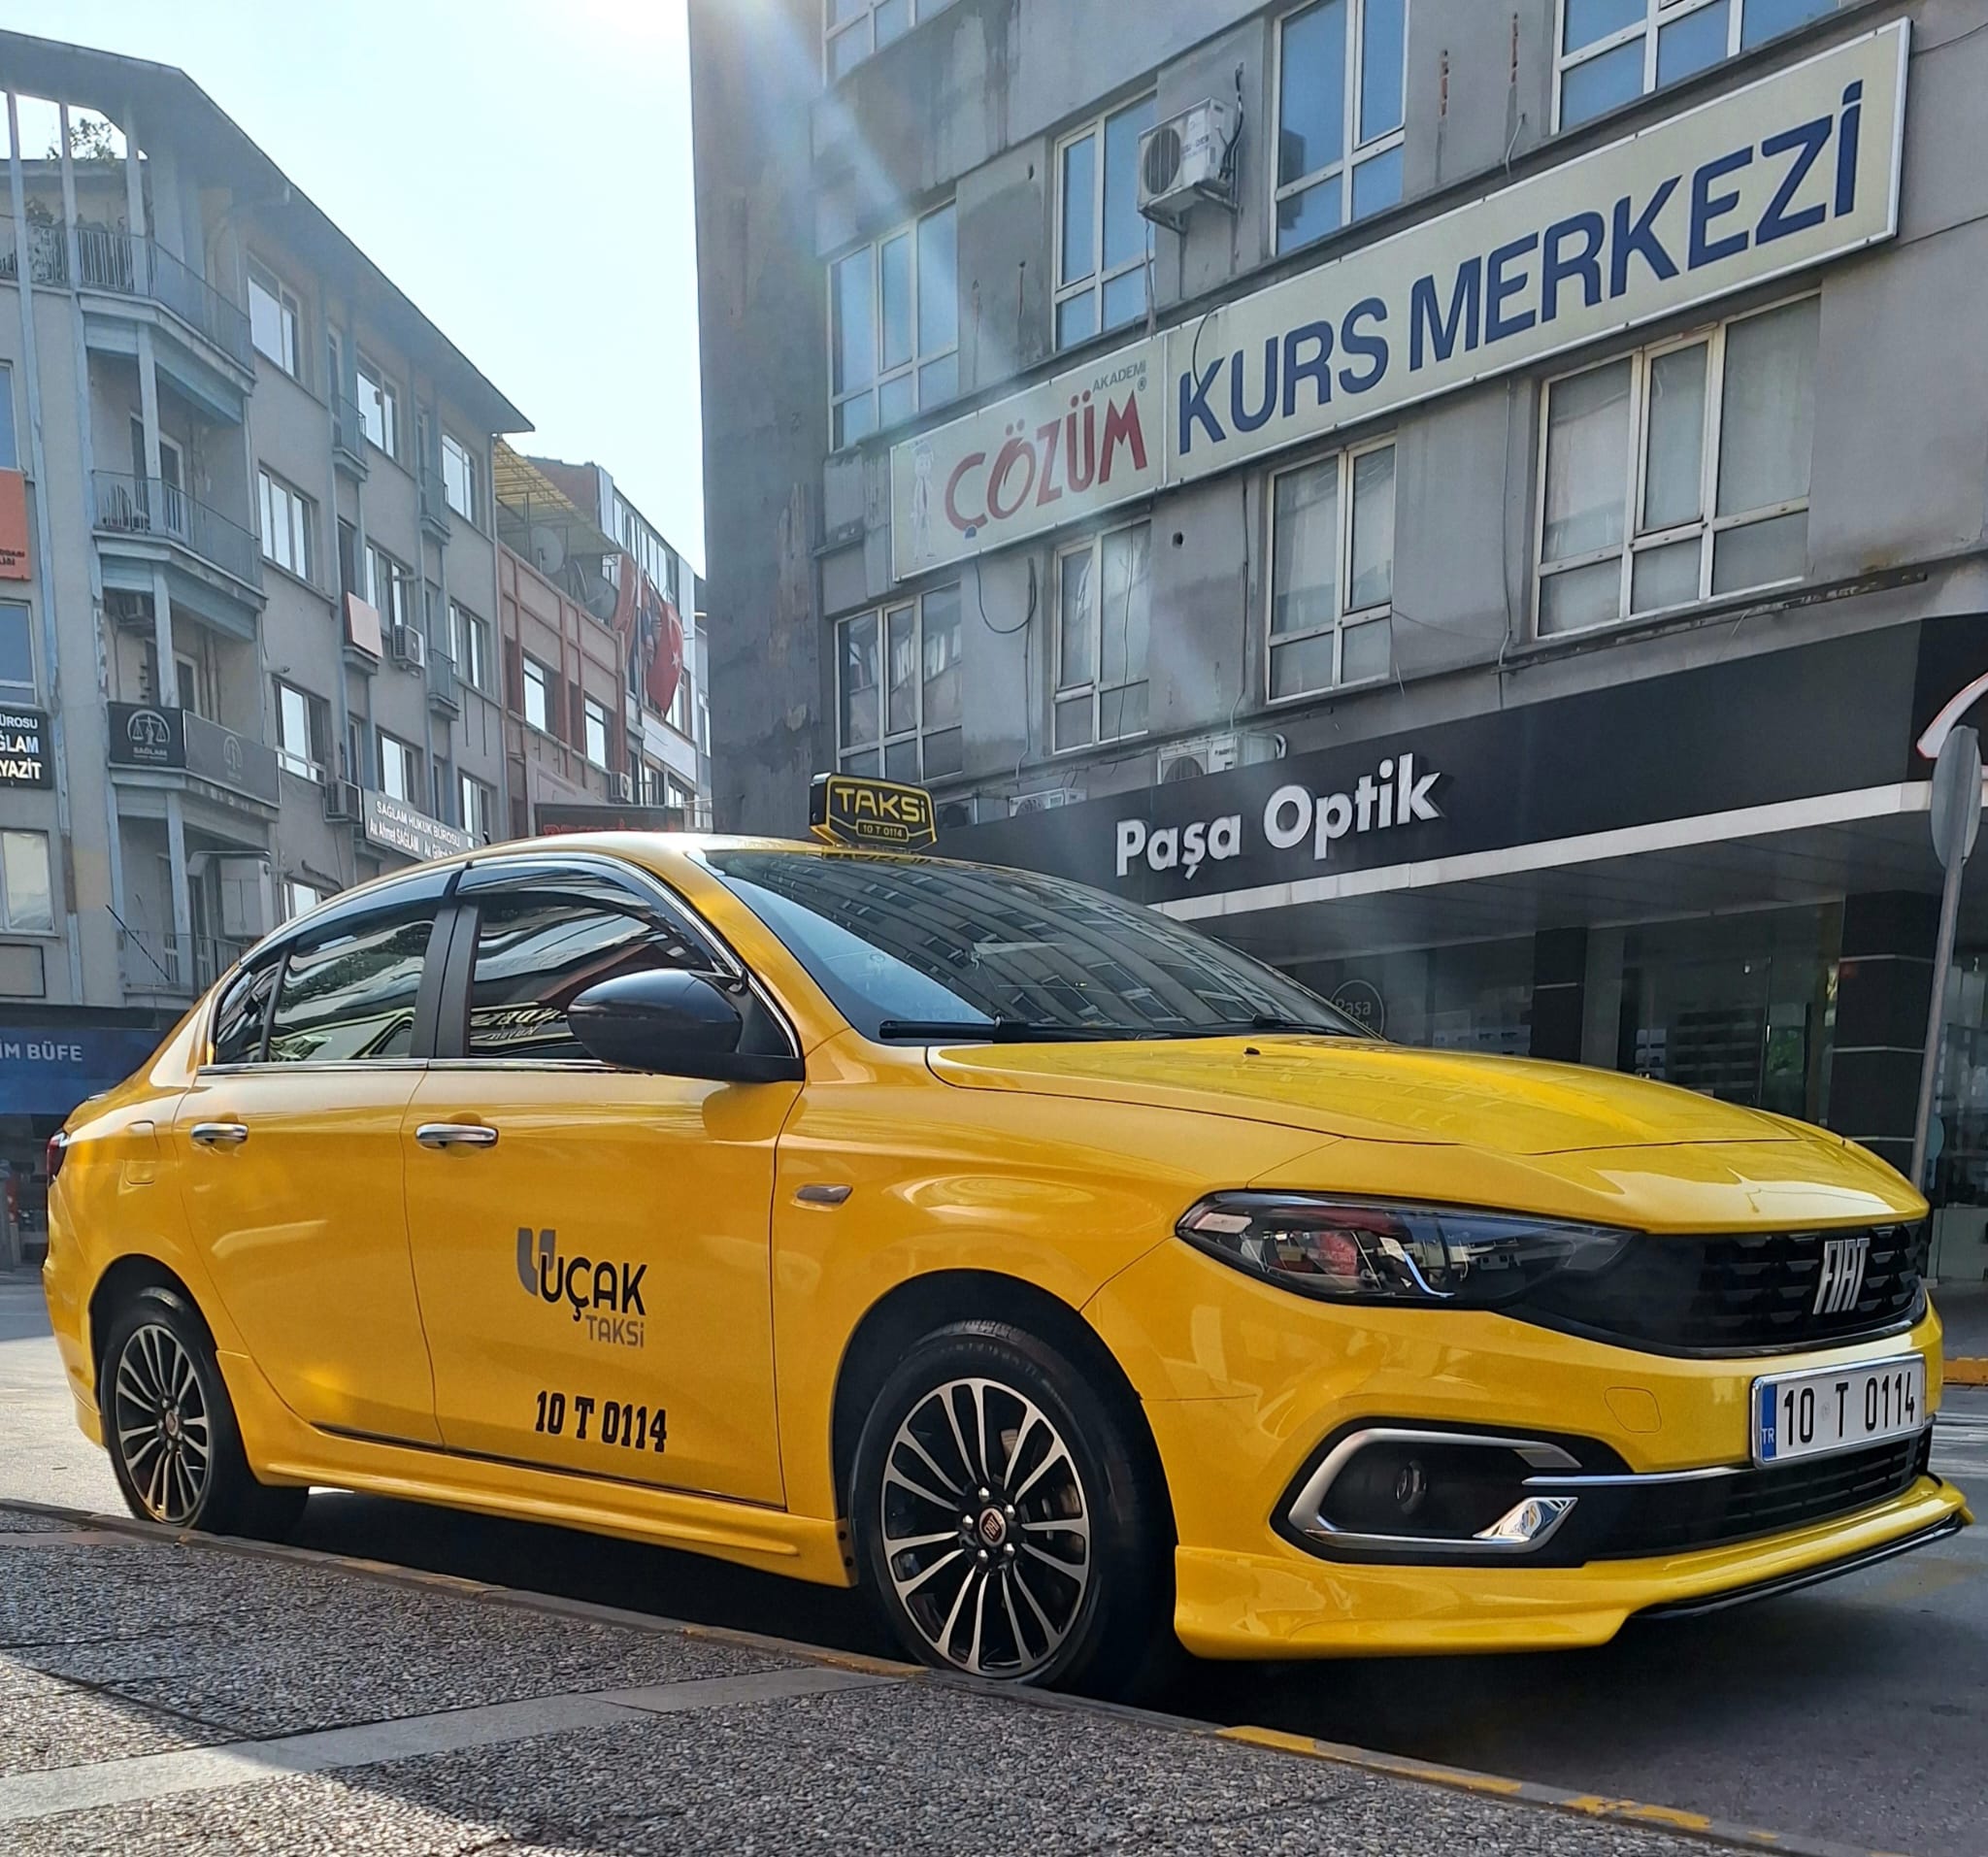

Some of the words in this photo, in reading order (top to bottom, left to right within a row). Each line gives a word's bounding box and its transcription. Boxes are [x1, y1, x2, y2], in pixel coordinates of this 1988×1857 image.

[1179, 297, 1389, 456] KURS
[1409, 79, 1863, 373] MERKEZİ
[944, 389, 1147, 539] ÇÖZÜM
[409, 814, 433, 835] HUKUK
[863, 824, 873, 833] 10
[883, 827, 903, 838] 0114
[1116, 814, 1242, 879] Paşa
[1264, 752, 1441, 860] Optik
[27, 1041, 83, 1062] BÜFE
[540, 1255, 647, 1322] UÇAK
[1812, 1238, 1871, 1315] FIAT
[536, 1391, 566, 1435] 10
[575, 1396, 595, 1440] T
[602, 1401, 667, 1453] 0114
[1762, 1427, 1775, 1445] TR
[1784, 1387, 1814, 1445] 10
[1836, 1382, 1849, 1438] T
[1865, 1372, 1915, 1431] 0114
